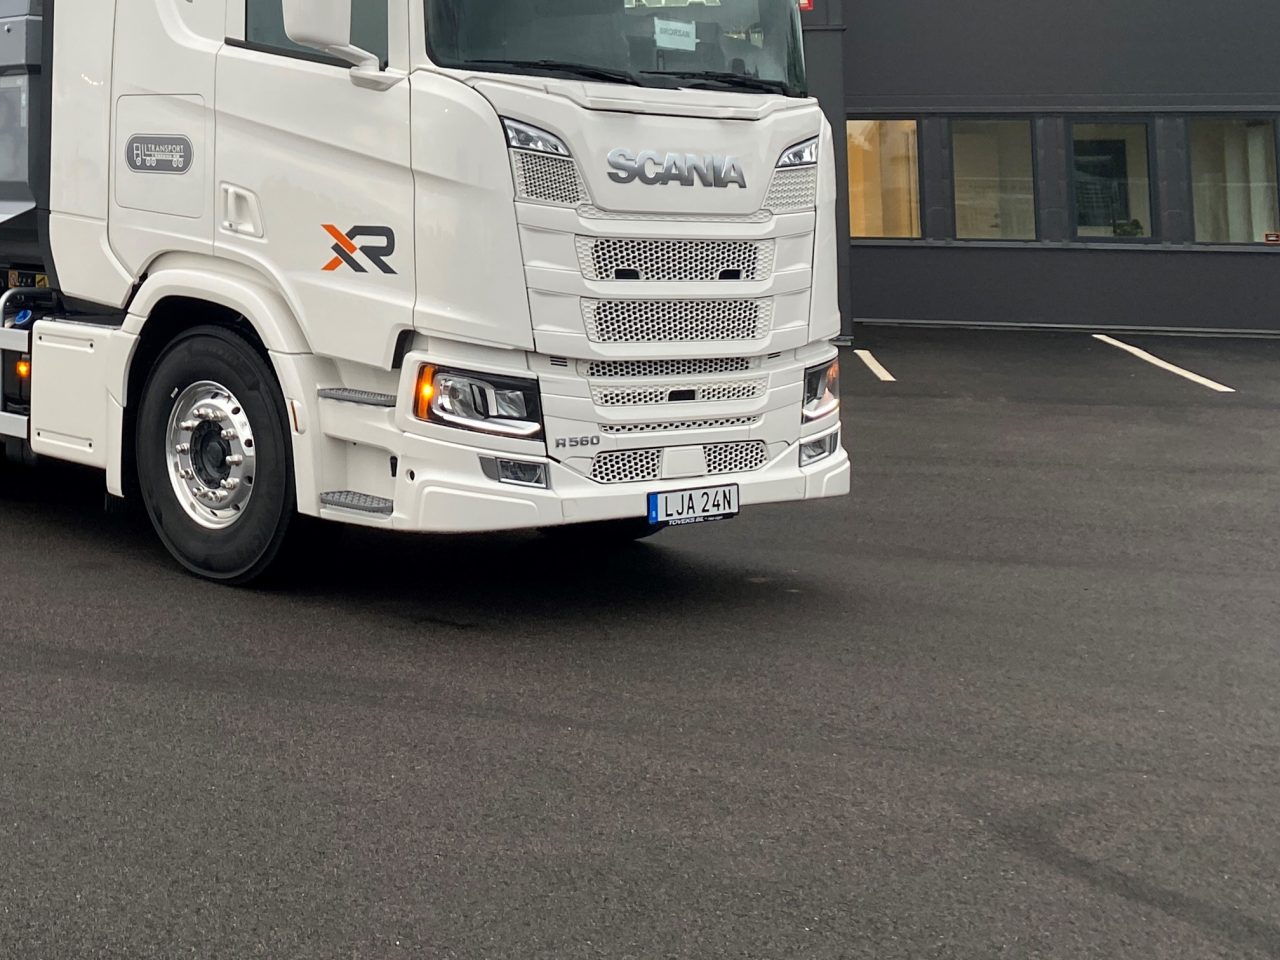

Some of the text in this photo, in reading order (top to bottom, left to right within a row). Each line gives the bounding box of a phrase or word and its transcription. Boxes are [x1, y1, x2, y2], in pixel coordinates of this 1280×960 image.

[148, 144, 184, 153] TRANSPORT
[606, 147, 747, 189] SCANIA
[320, 224, 399, 275] XR
[555, 435, 600, 448] R 560
[664, 488, 732, 518] LJA 24N
